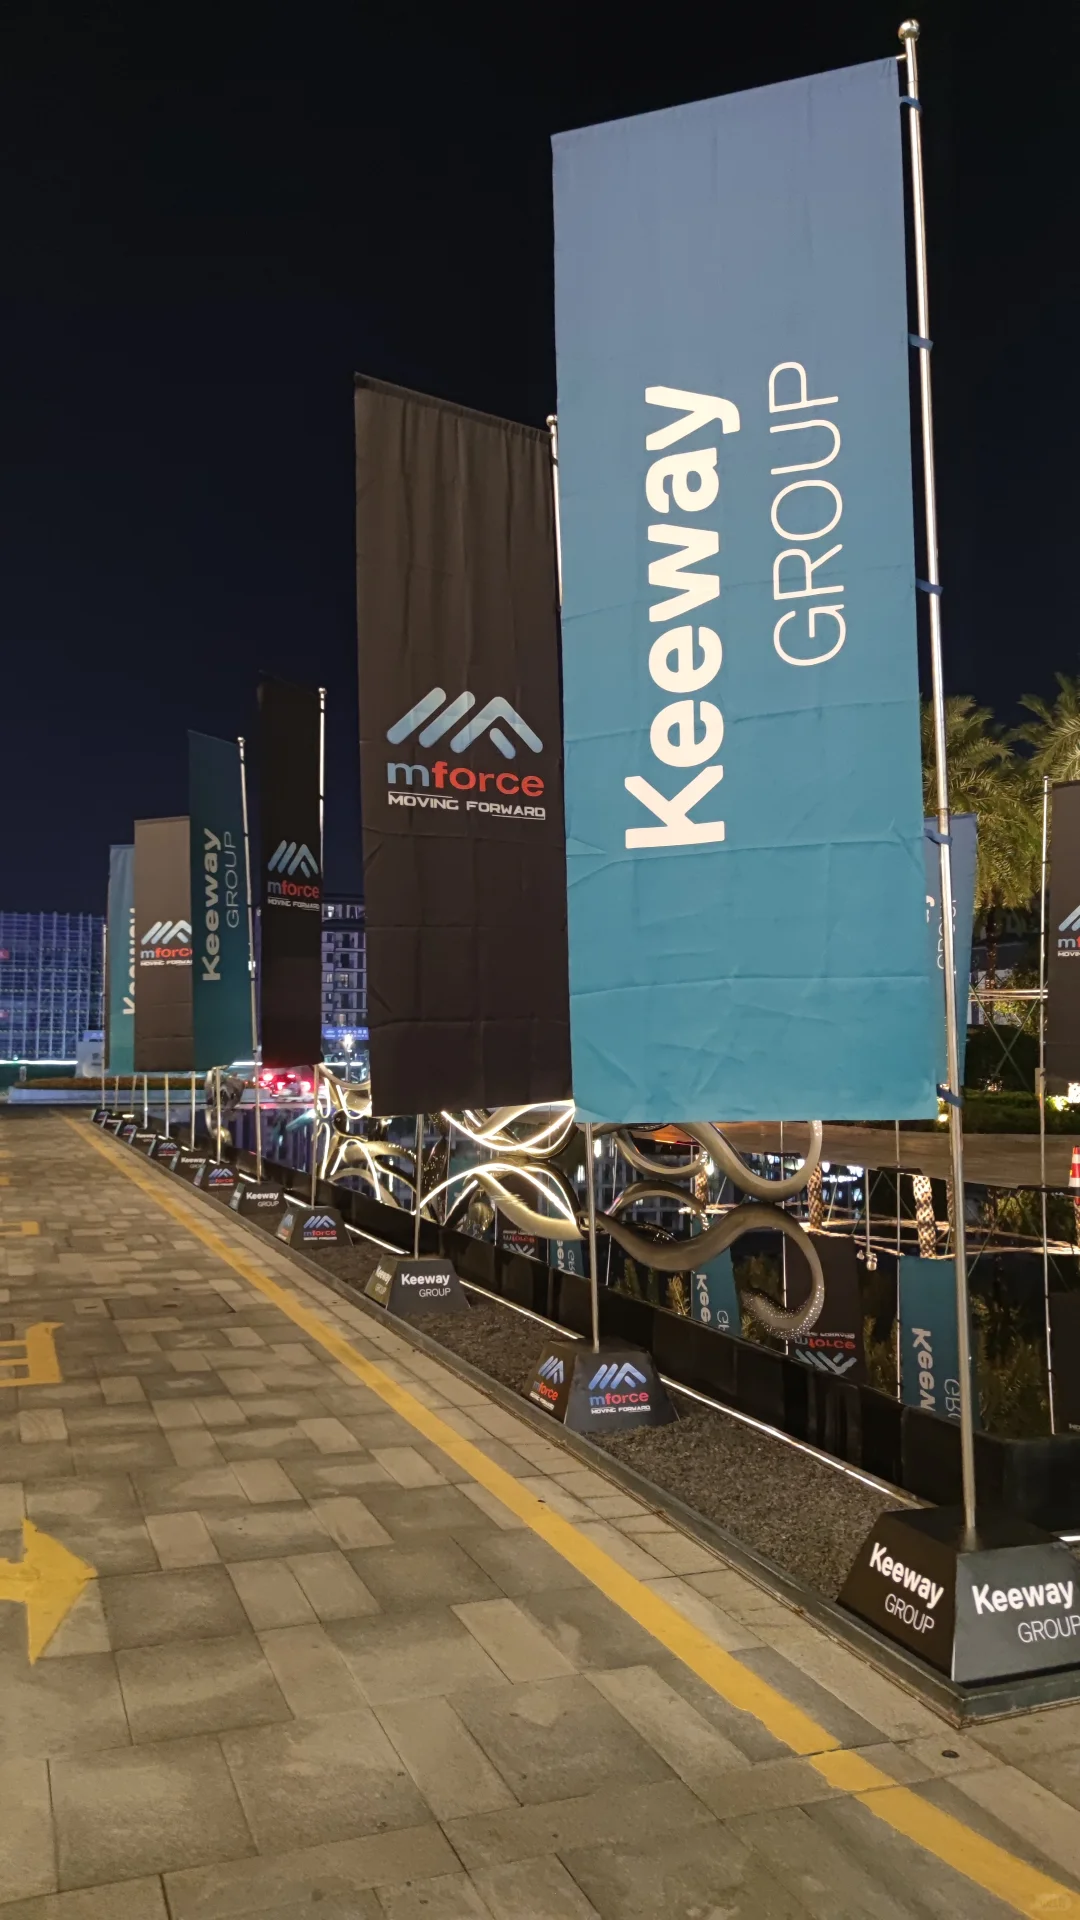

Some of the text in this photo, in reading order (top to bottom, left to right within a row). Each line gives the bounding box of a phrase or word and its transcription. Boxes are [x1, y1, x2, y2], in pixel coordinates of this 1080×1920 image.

[769, 361, 846, 666] GROUP
[625, 386, 740, 849] Keeway
[387, 761, 545, 797] mforce
[388, 793, 545, 819] MOVING FORWARD
[224, 831, 239, 928] GROUP
[267, 879, 320, 899] mforce
[202, 828, 221, 980] Keeway
[246, 1191, 279, 1200] Keeway
[257, 1200, 279, 1208] GROUP
[303, 1229, 337, 1237] mforce
[401, 1273, 450, 1286] Keeway
[418, 1287, 451, 1298] GROUP
[532, 1381, 559, 1401] mforce
[589, 1392, 649, 1406] mforce
[591, 1404, 651, 1415] MOVING FORWARD
[869, 1542, 945, 1610] Keeway
[971, 1580, 1074, 1615] Keeway
[884, 1593, 935, 1634] GROUP
[1017, 1615, 1080, 1643] GROUP
